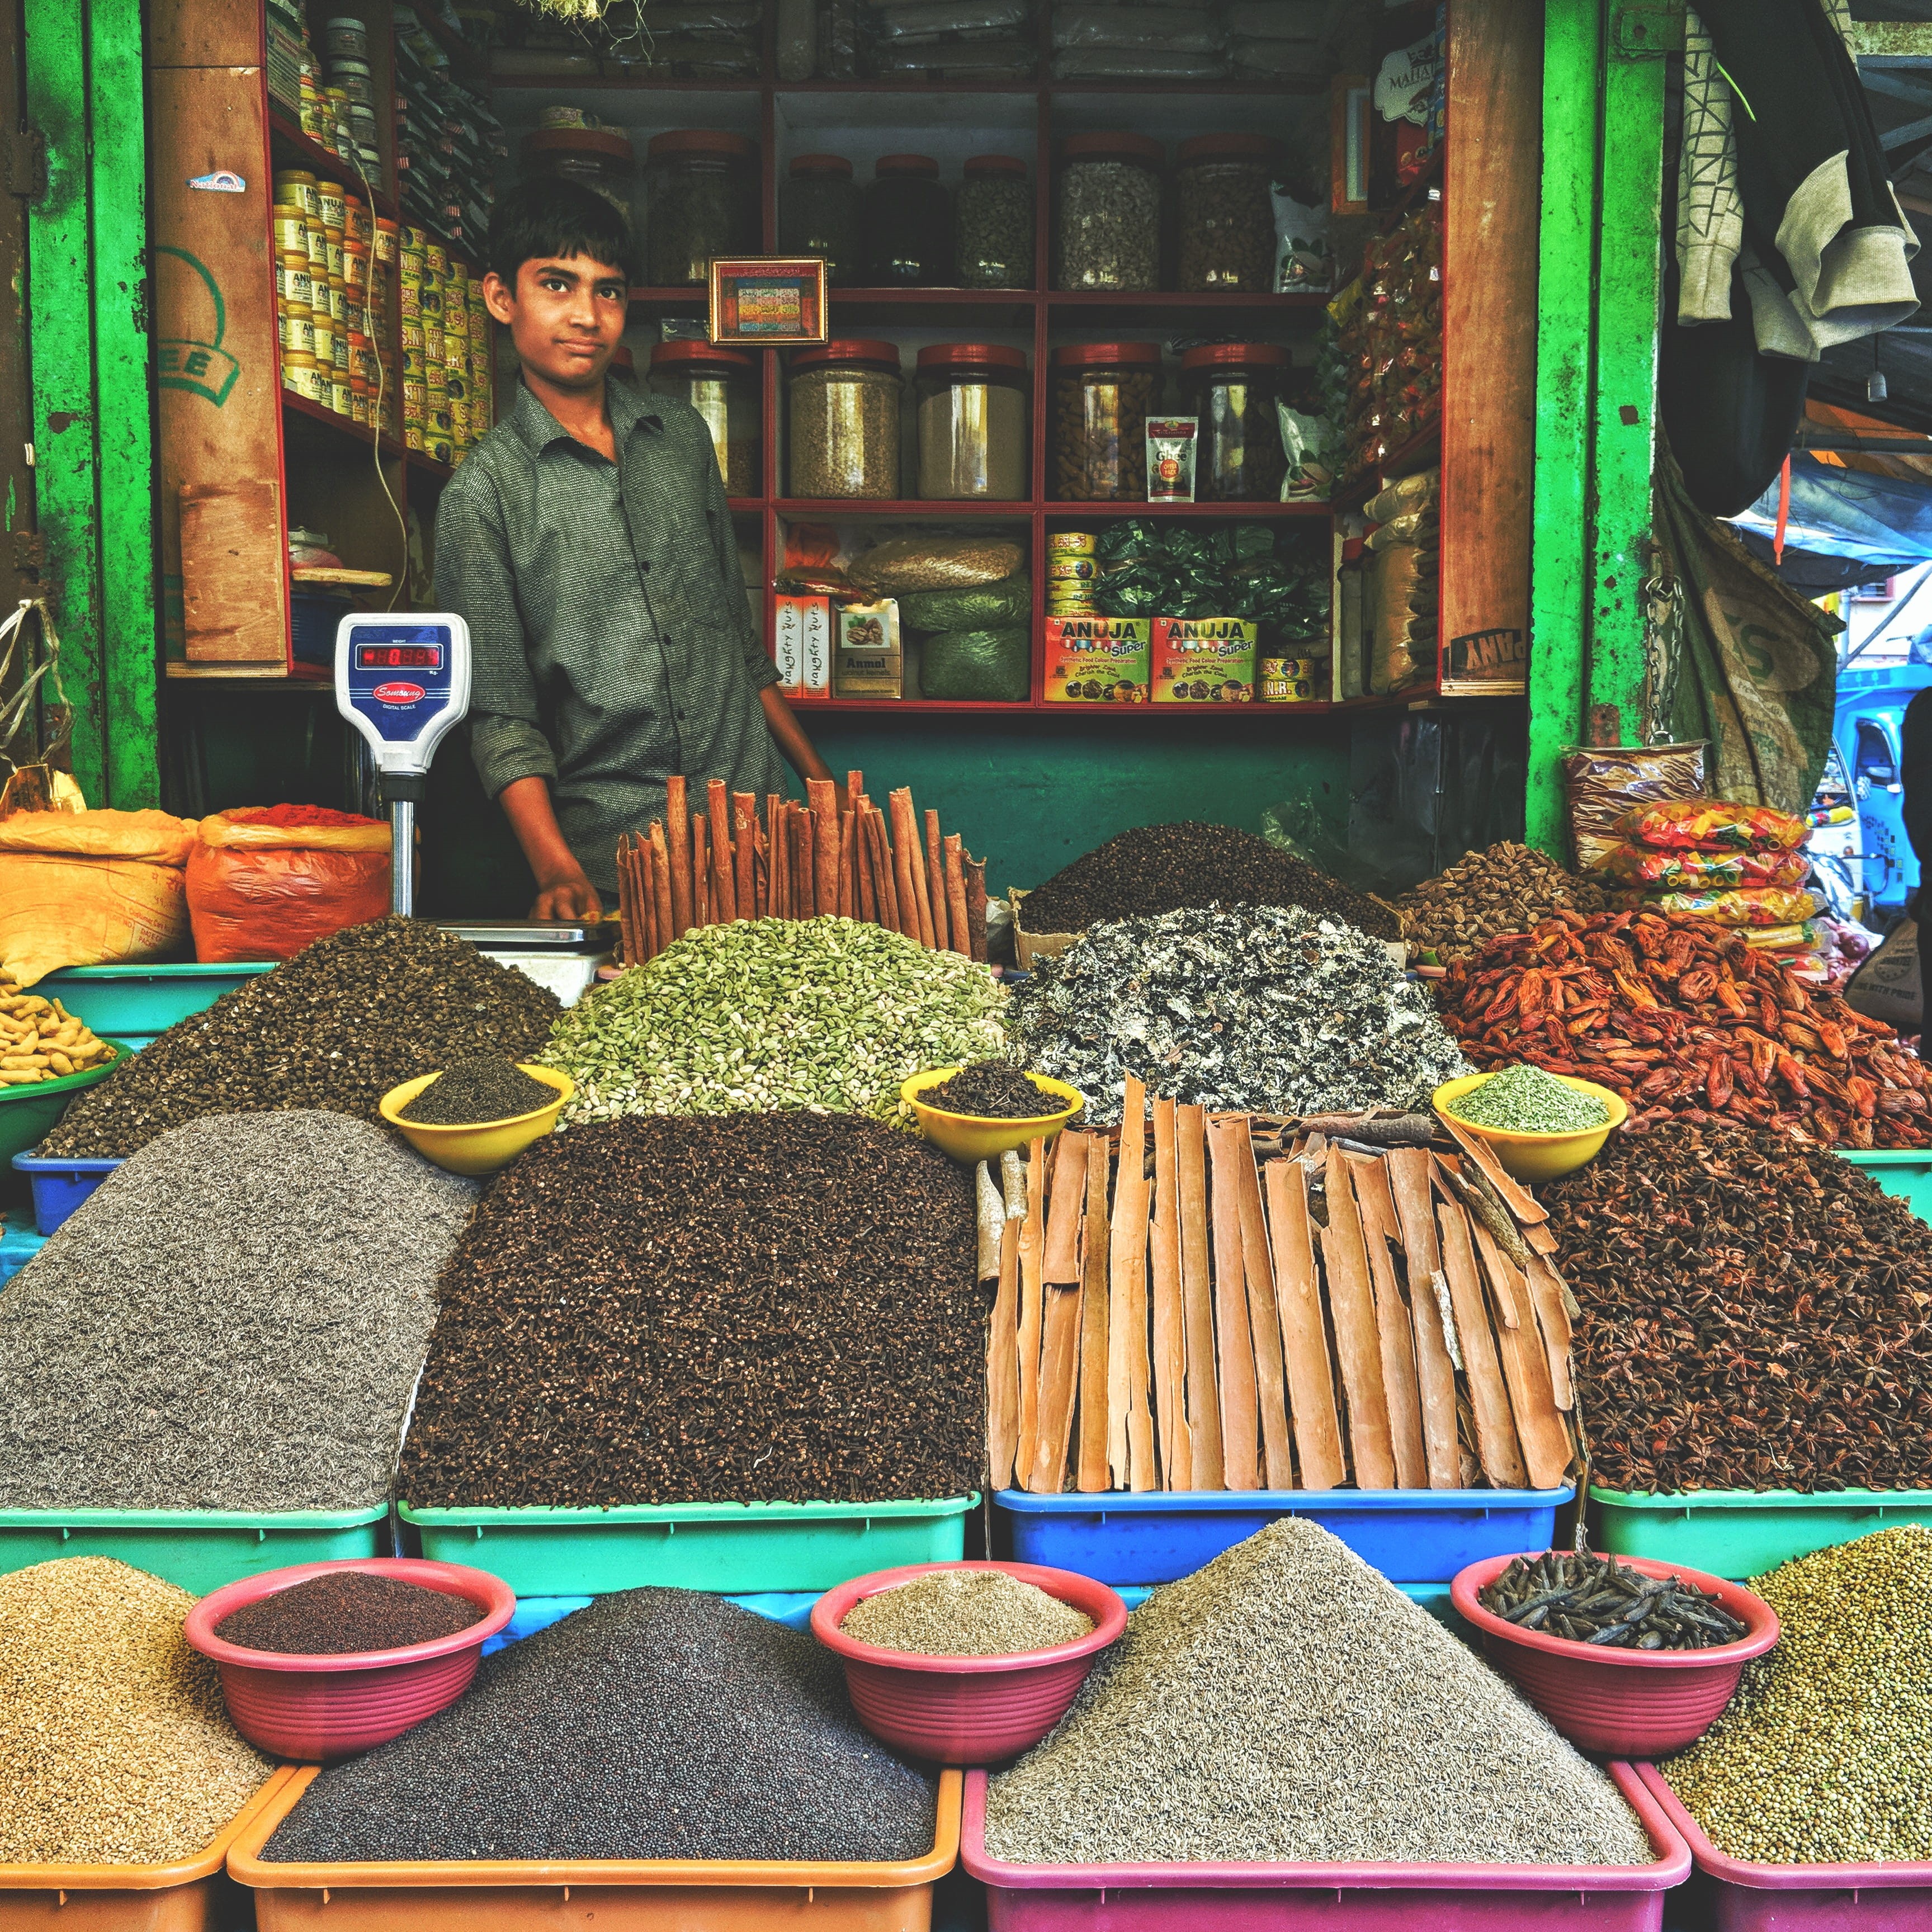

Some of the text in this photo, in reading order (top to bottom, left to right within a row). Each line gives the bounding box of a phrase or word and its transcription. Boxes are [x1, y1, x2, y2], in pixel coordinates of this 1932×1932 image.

[191, 179, 237, 189] National
[1156, 450, 1187, 461] Ghee
[1062, 621, 1137, 639] ANUJA
[1168, 622, 1244, 639] ANUJA
[1111, 641, 1146, 657] Super
[1218, 640, 1253, 657] Super
[846, 657, 886, 668] Anmol
